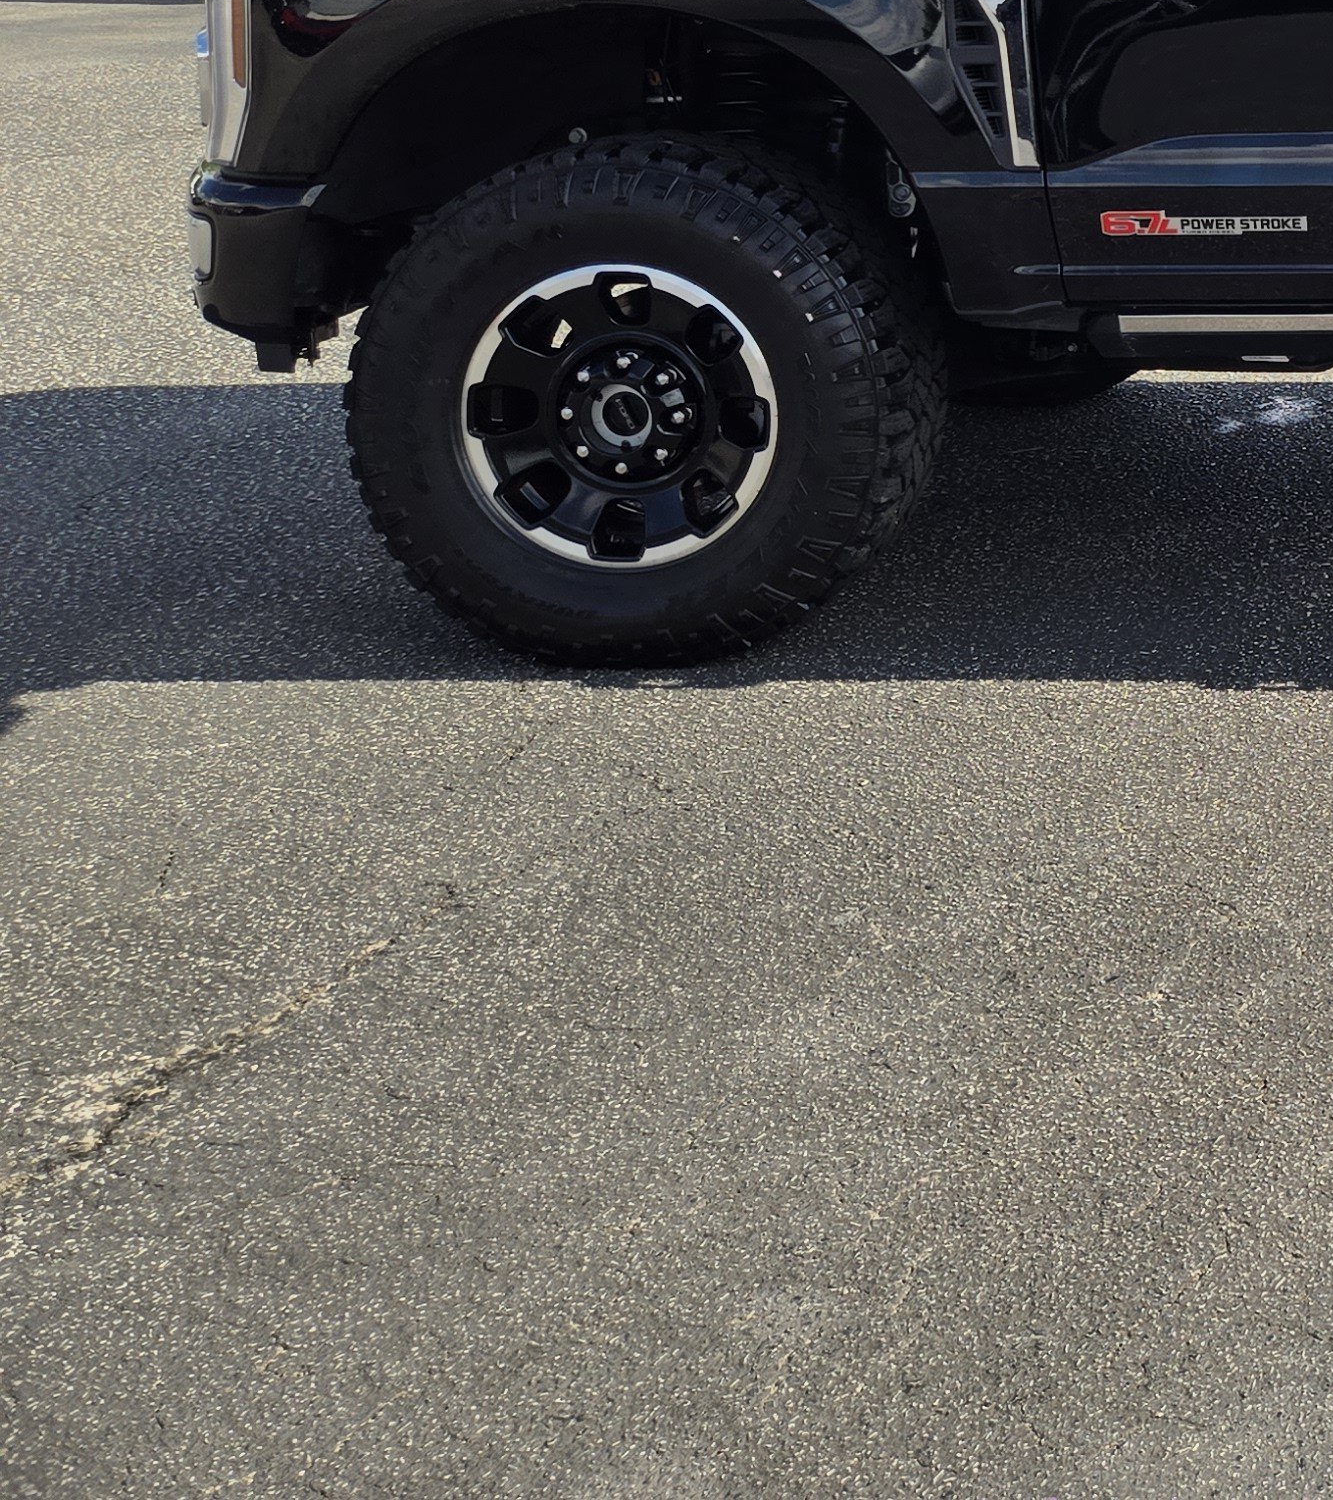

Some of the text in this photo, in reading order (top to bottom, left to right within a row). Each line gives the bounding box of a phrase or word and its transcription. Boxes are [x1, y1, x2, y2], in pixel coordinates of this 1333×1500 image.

[1101, 211, 1302, 235] 6.7L POWER STROKE
